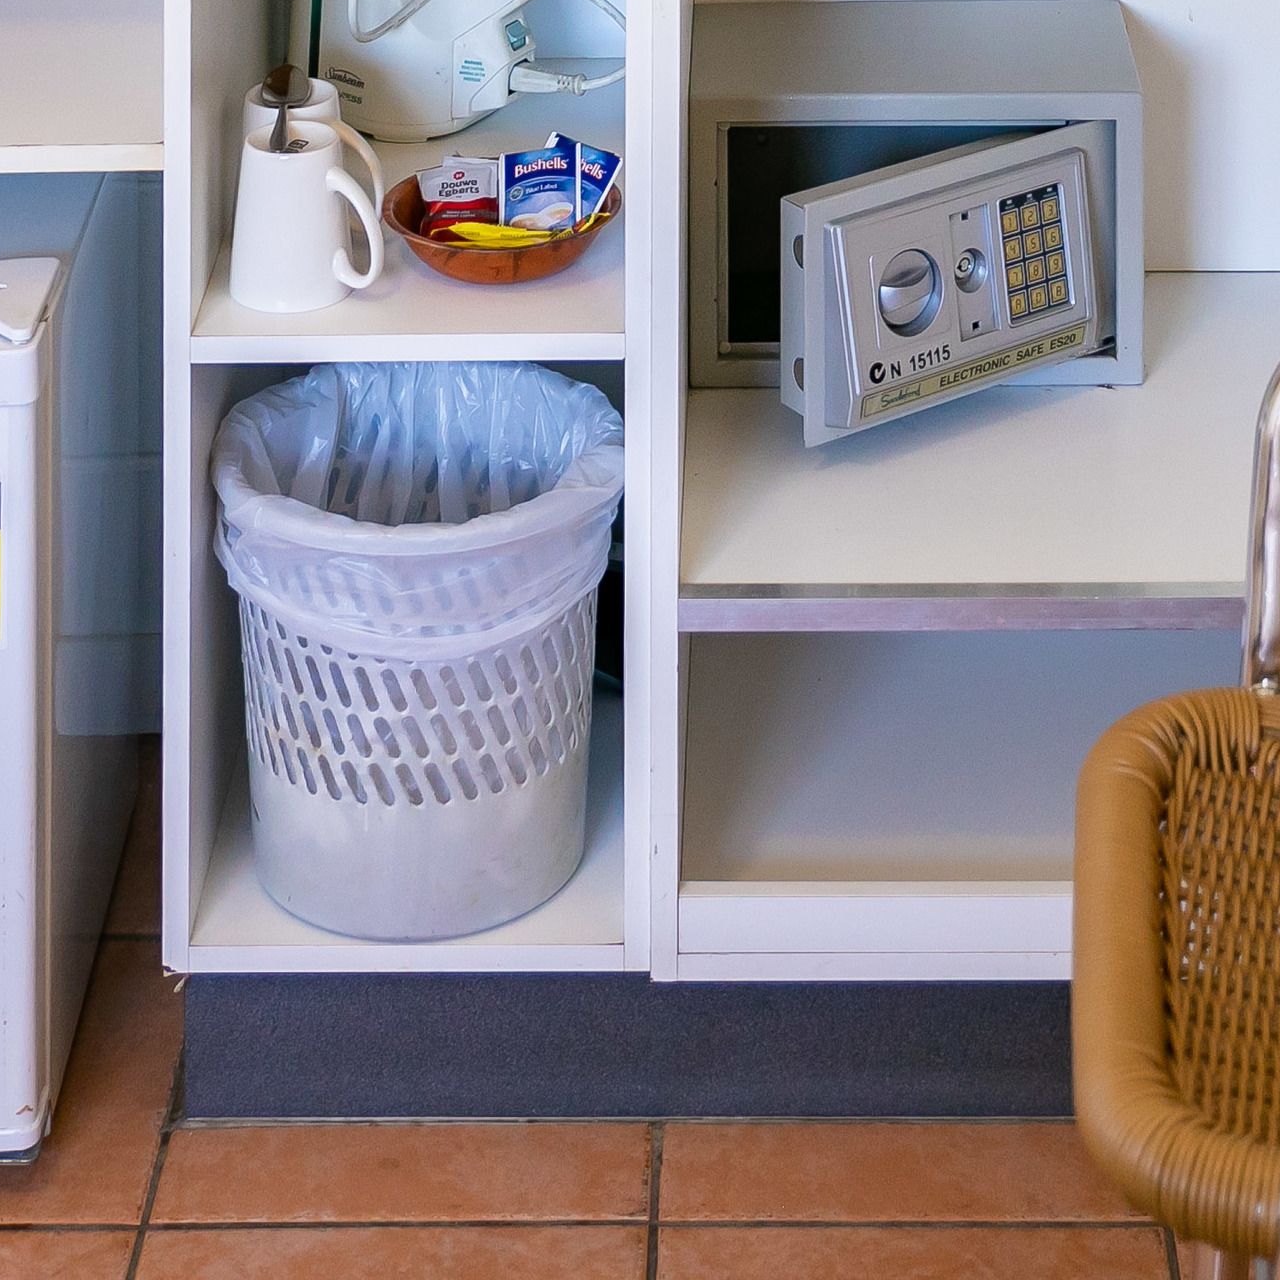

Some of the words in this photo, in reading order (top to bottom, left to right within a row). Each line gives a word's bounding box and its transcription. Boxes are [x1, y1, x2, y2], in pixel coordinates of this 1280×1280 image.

[325, 67, 365, 89] Sunbeam
[514, 157, 568, 178] Bushells
[581, 159, 604, 180] hells
[439, 187, 479, 197] Egberts
[441, 180, 477, 189] Douwe
[890, 361, 901, 379] N
[909, 344, 951, 371] 15115
[939, 355, 1010, 387] ELECTRONIC
[1016, 343, 1044, 362] SAFE
[1049, 333, 1076, 352] ES20
